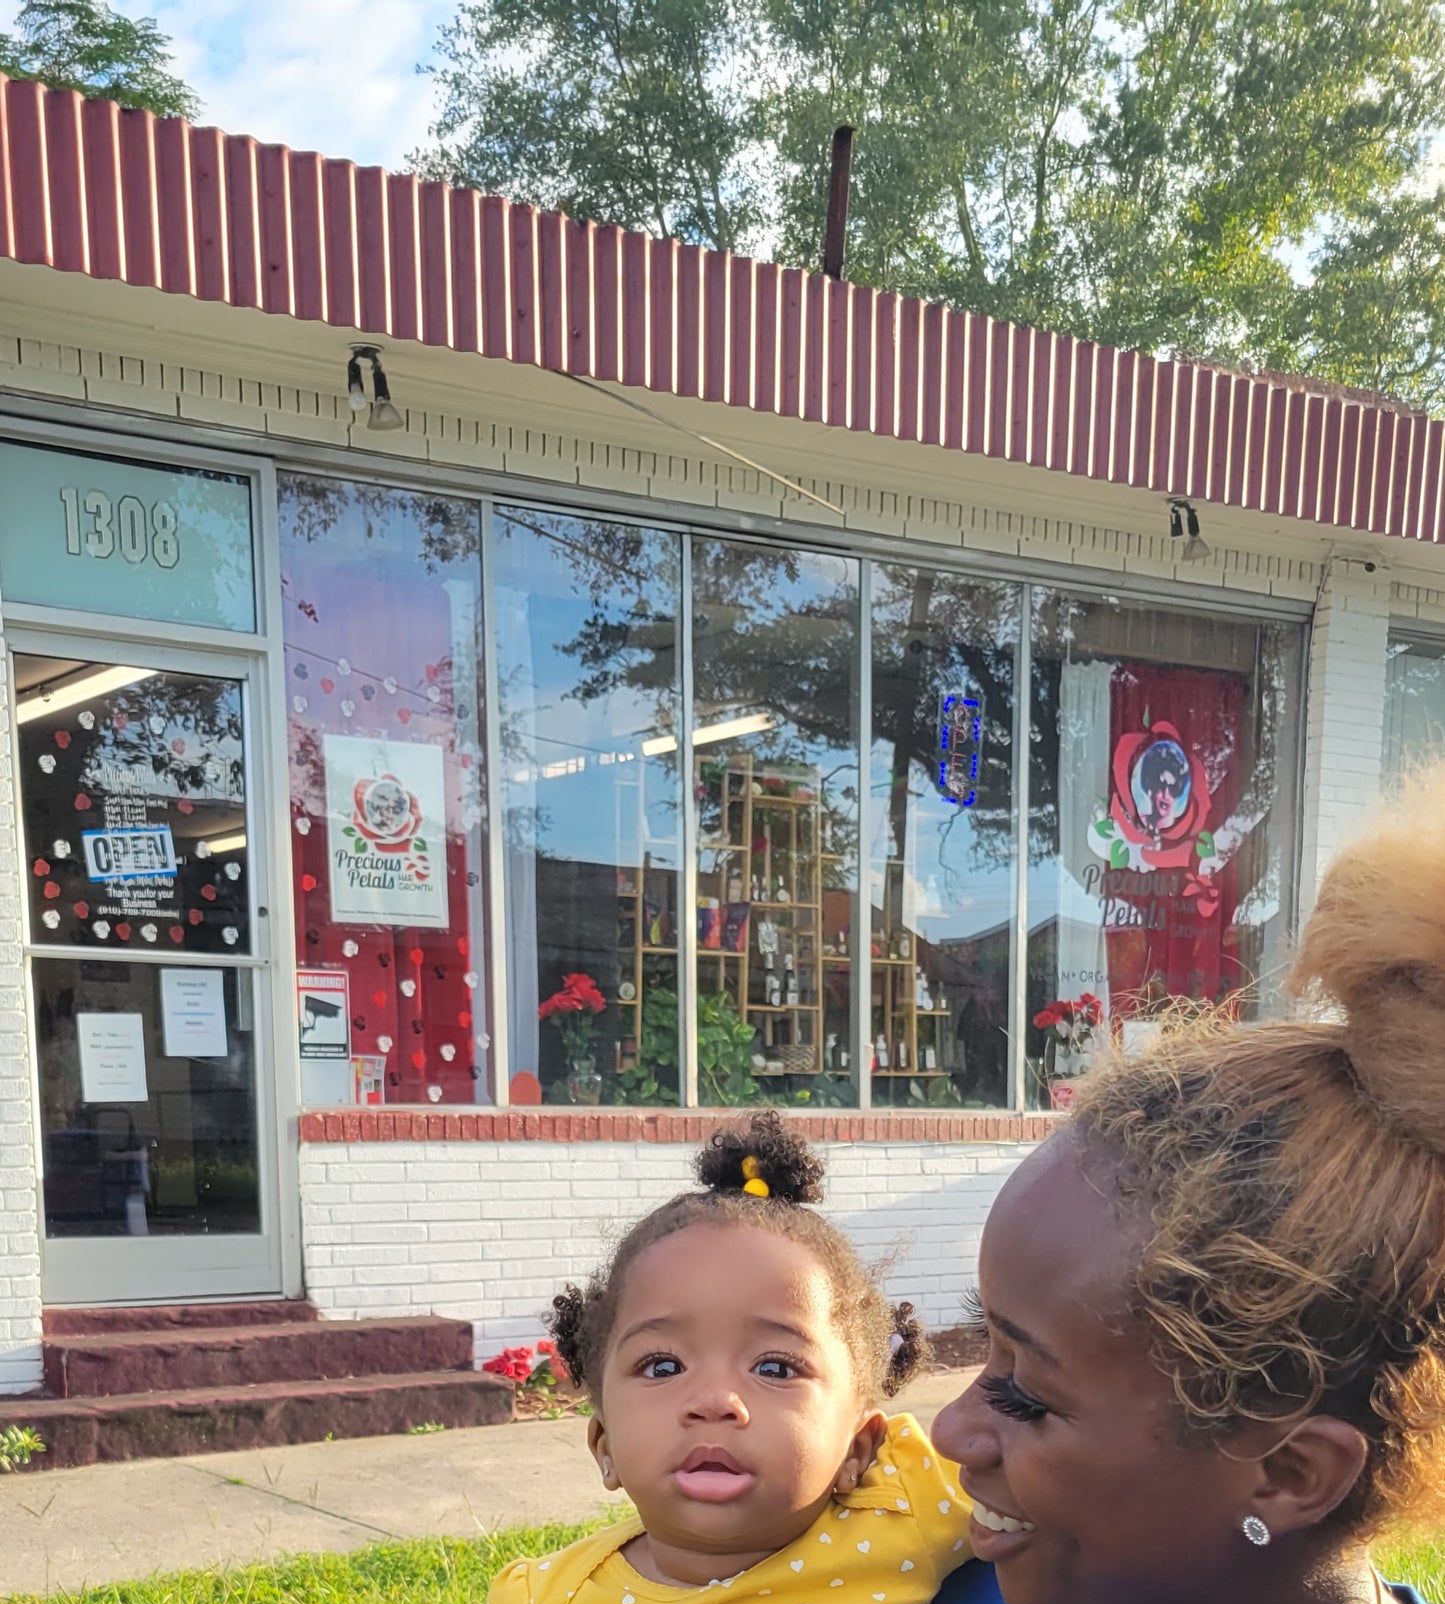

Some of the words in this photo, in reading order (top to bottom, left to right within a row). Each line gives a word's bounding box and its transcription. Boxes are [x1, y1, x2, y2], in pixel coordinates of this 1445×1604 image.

[60, 486, 181, 569] 1308
[92, 833, 170, 874] OPEN
[335, 848, 402, 872] Precious
[105, 888, 131, 899] Thank
[347, 868, 396, 890] Petals
[1082, 863, 1181, 897] Precious
[1098, 896, 1167, 930] Petals
